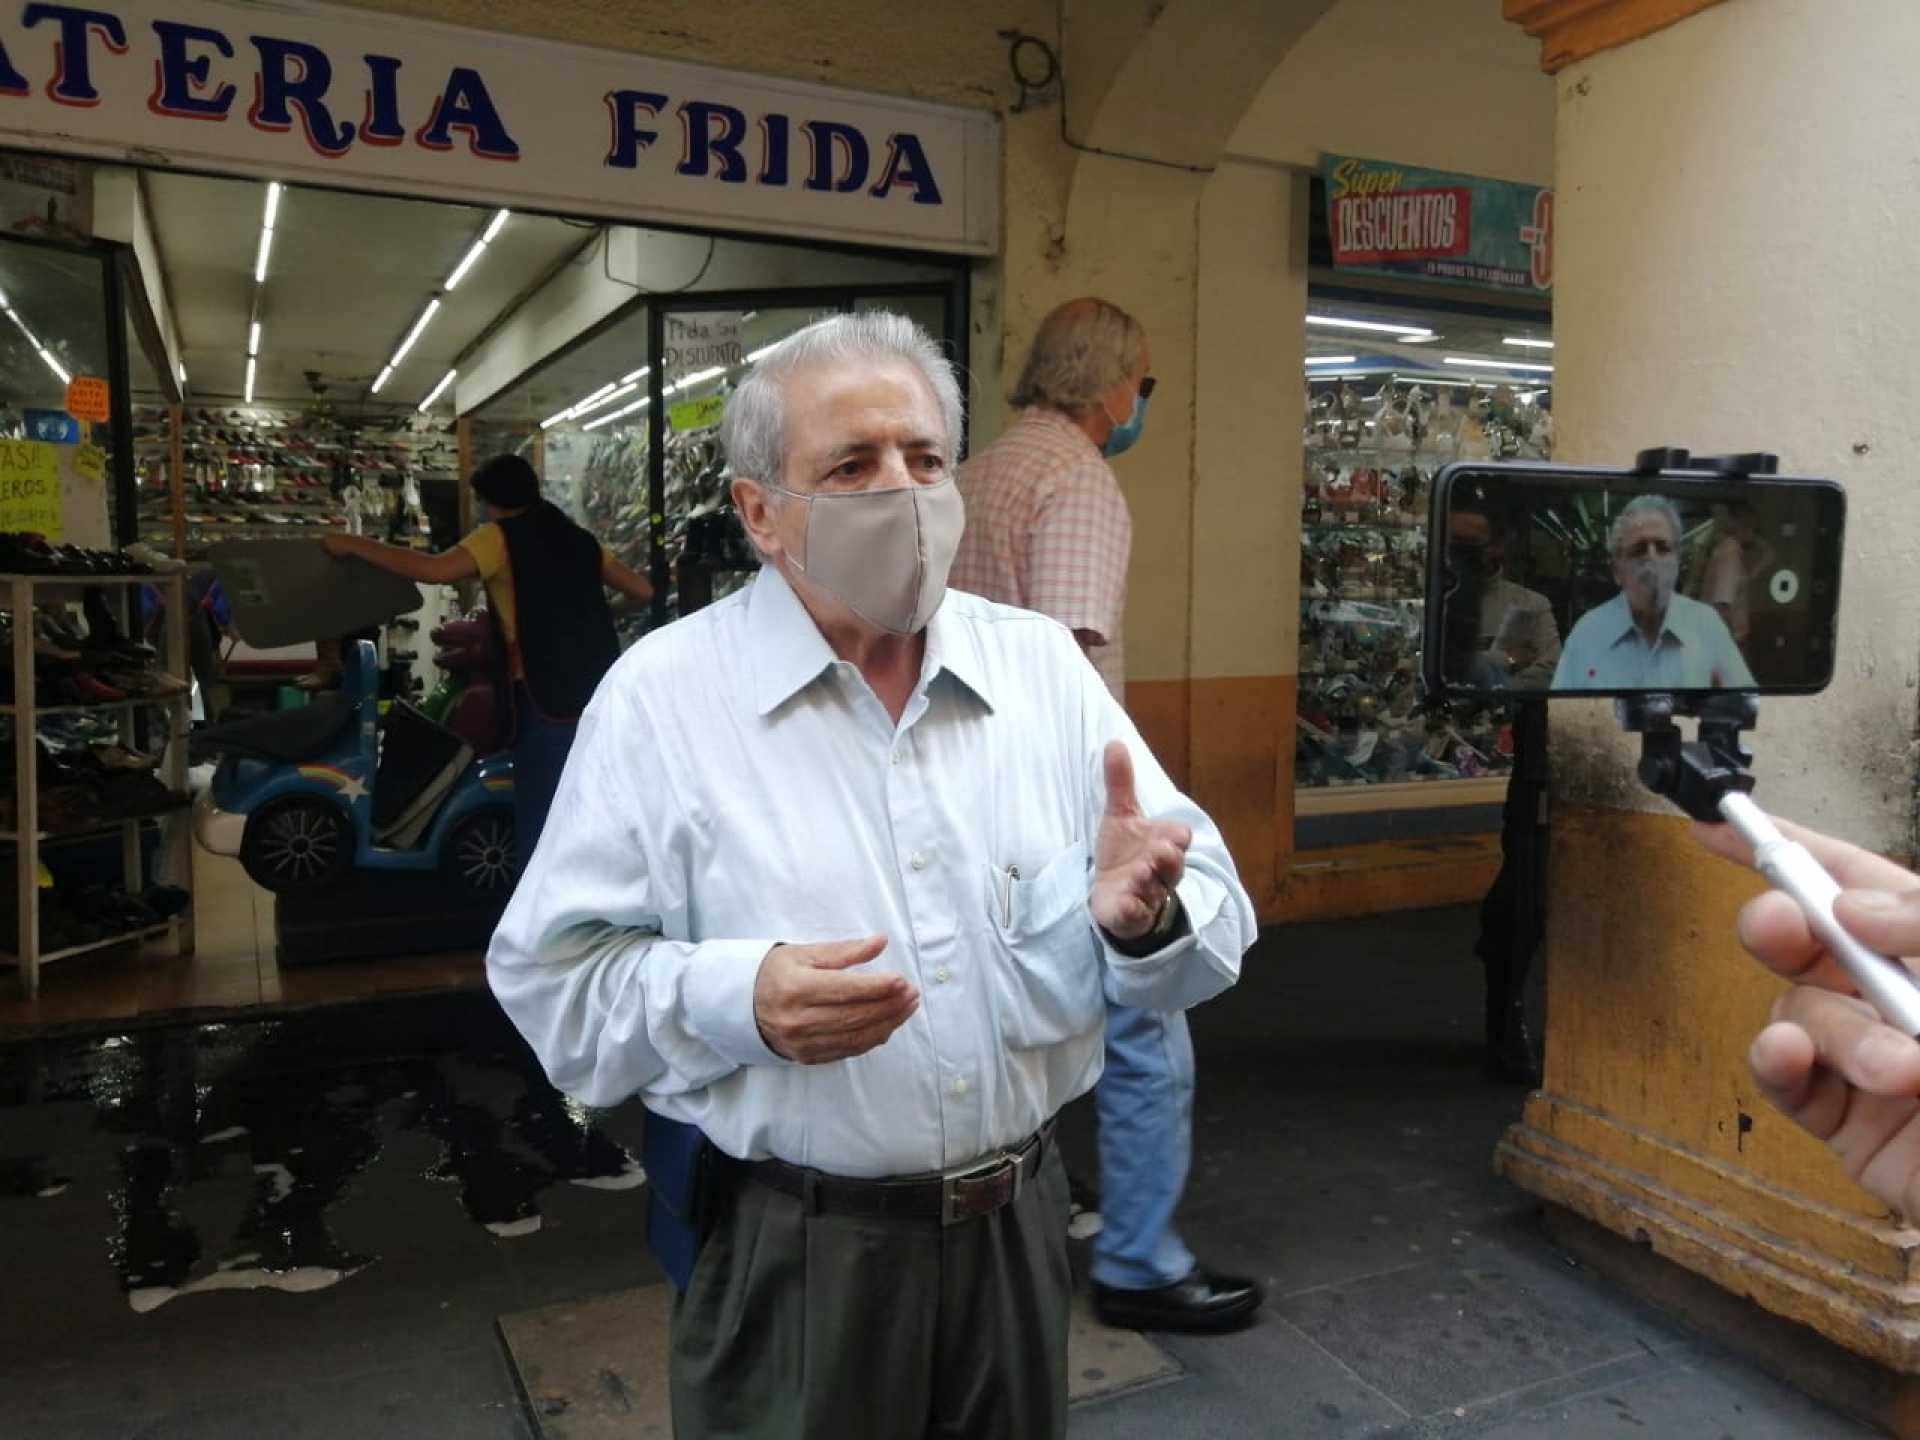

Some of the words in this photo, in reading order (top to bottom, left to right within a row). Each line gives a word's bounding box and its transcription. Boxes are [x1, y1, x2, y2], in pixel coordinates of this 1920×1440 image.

[603, 89, 943, 205] FRIDA
[1332, 159, 1404, 199] Super
[1338, 191, 1458, 252] DESCUENTOS
[0, 479, 47, 502] EROS
